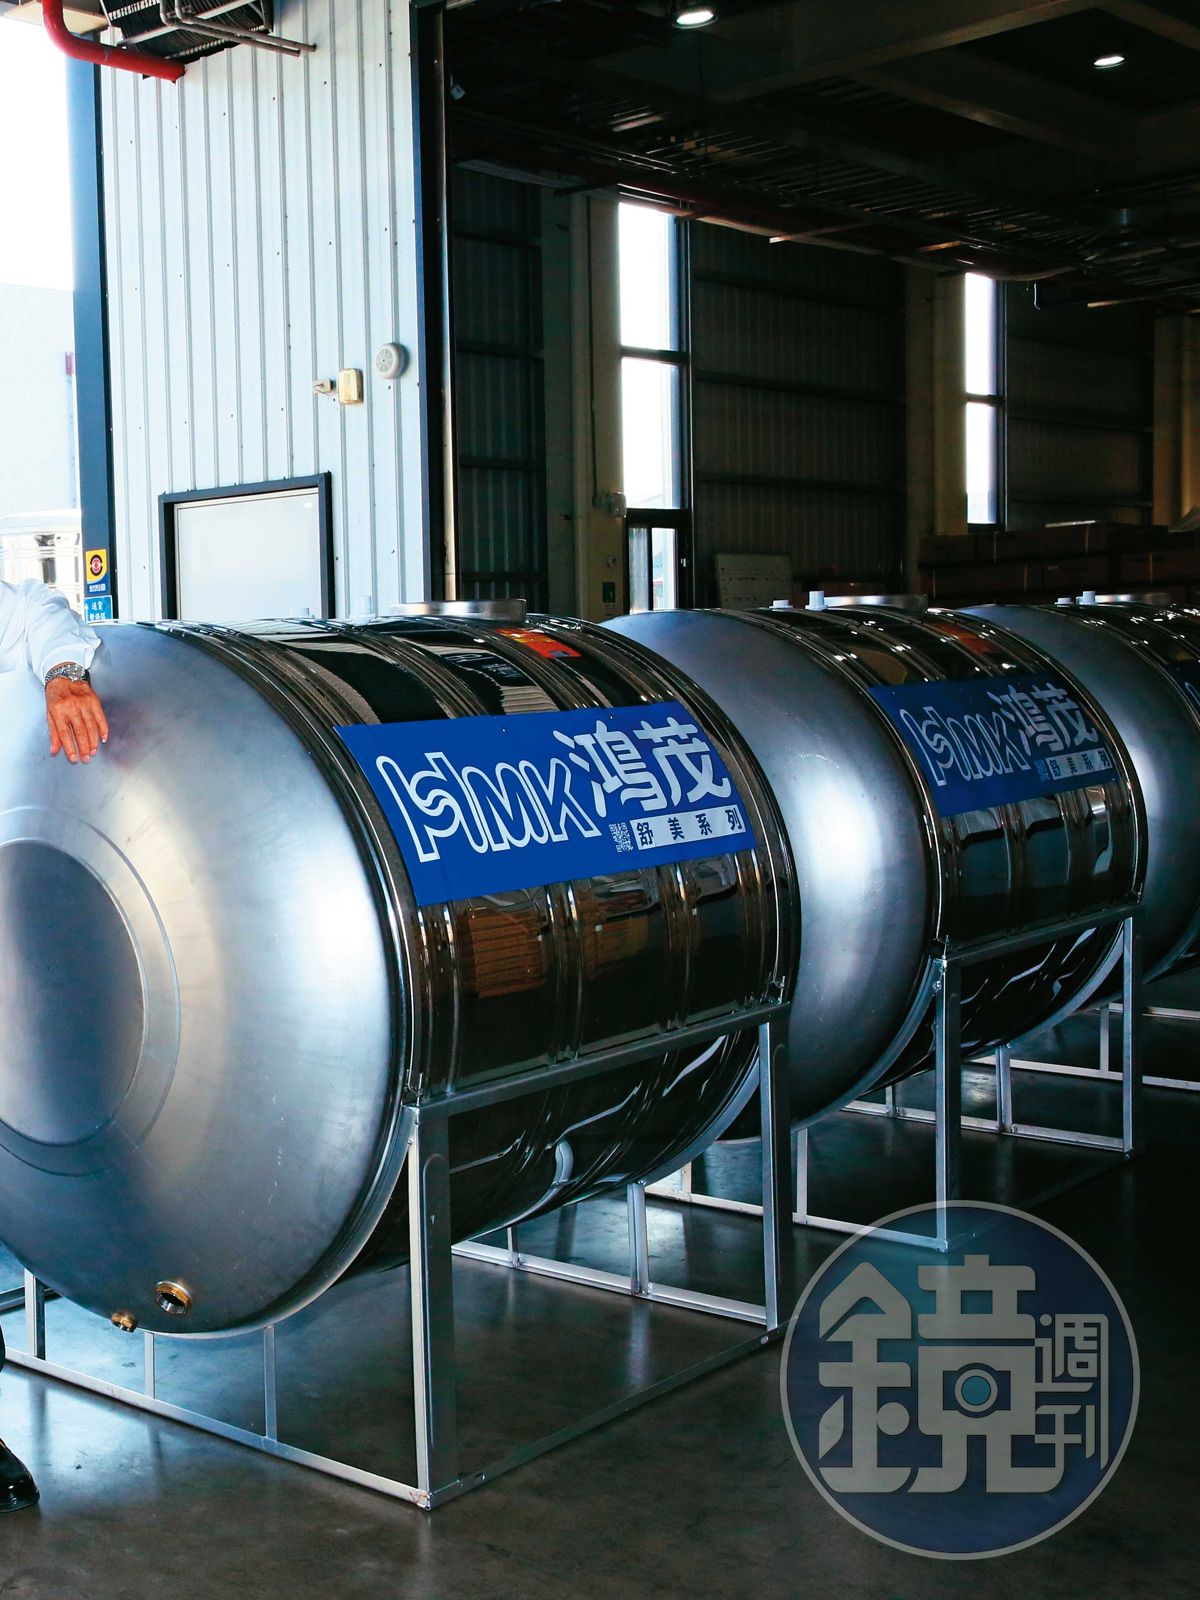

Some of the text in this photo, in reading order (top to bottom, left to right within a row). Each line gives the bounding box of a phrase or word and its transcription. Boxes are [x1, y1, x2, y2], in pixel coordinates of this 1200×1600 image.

[986, 682, 1098, 755] 鴻茂
[552, 716, 731, 818] 鴻茂
[636, 807, 742, 846] 舒美系列
